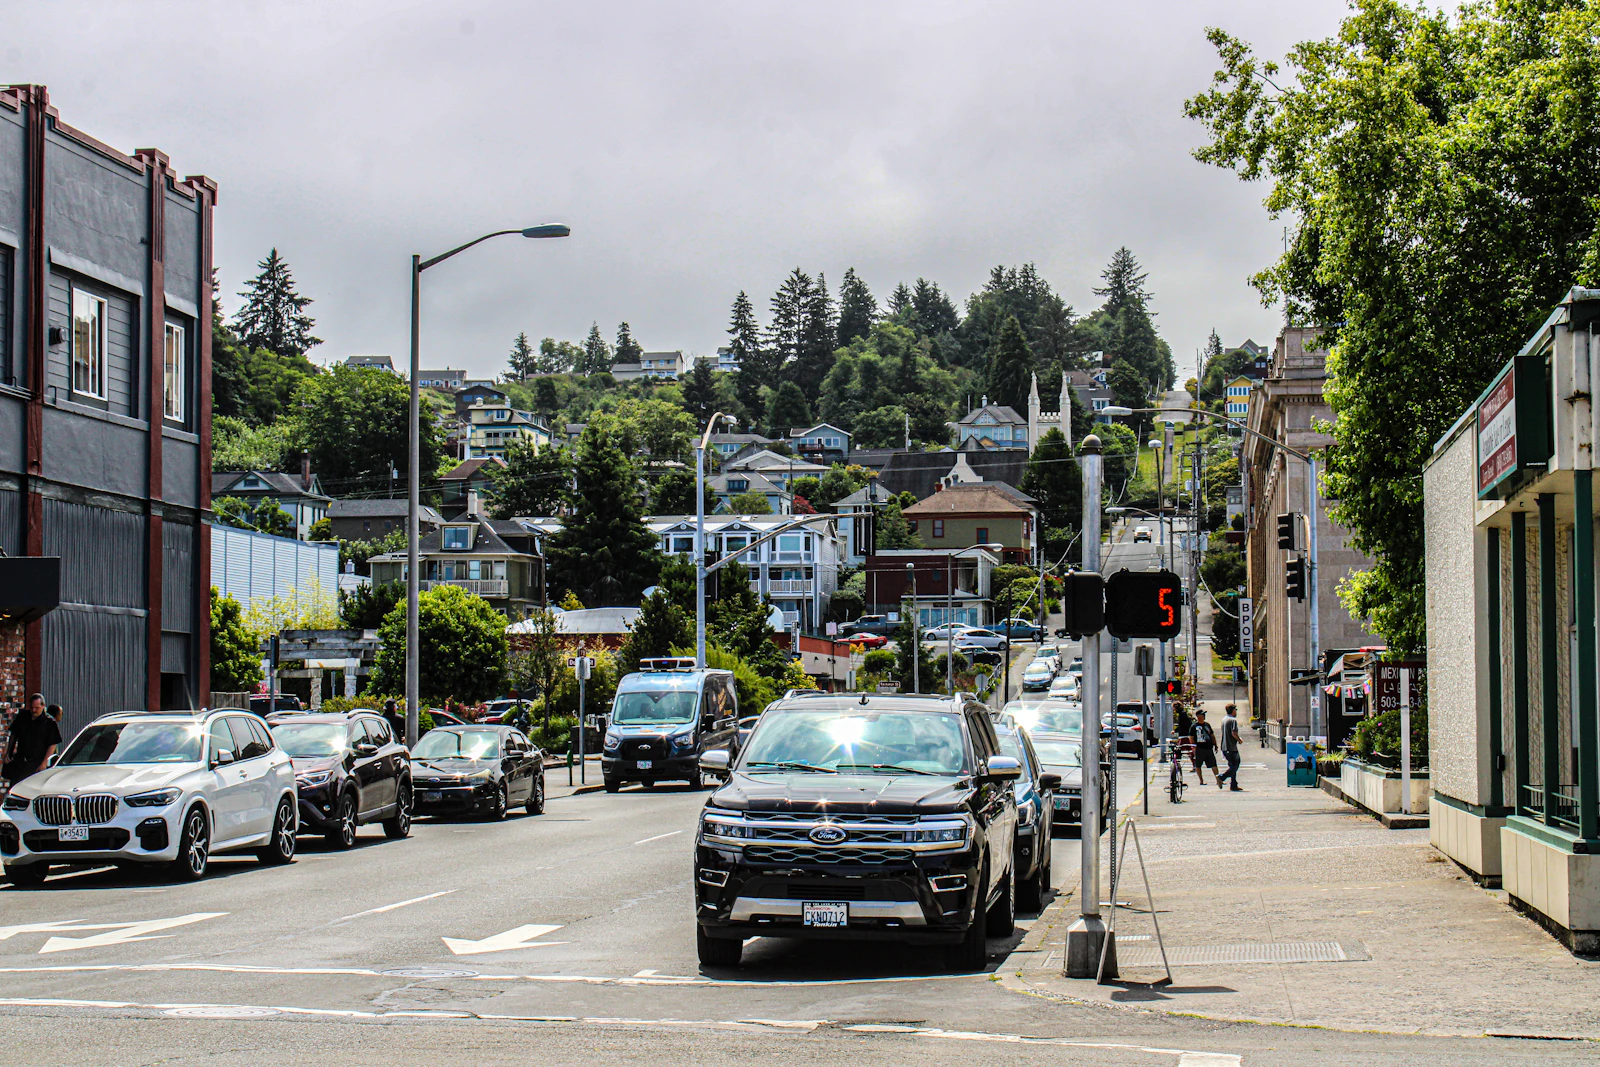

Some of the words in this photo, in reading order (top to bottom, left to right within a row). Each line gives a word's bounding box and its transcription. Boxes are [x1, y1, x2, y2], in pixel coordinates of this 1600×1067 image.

[1159, 588, 1173, 626] 5
[1242, 603, 1251, 647] BPOE
[1381, 667, 1415, 679] MEXIN
[818, 830, 837, 839] Ford
